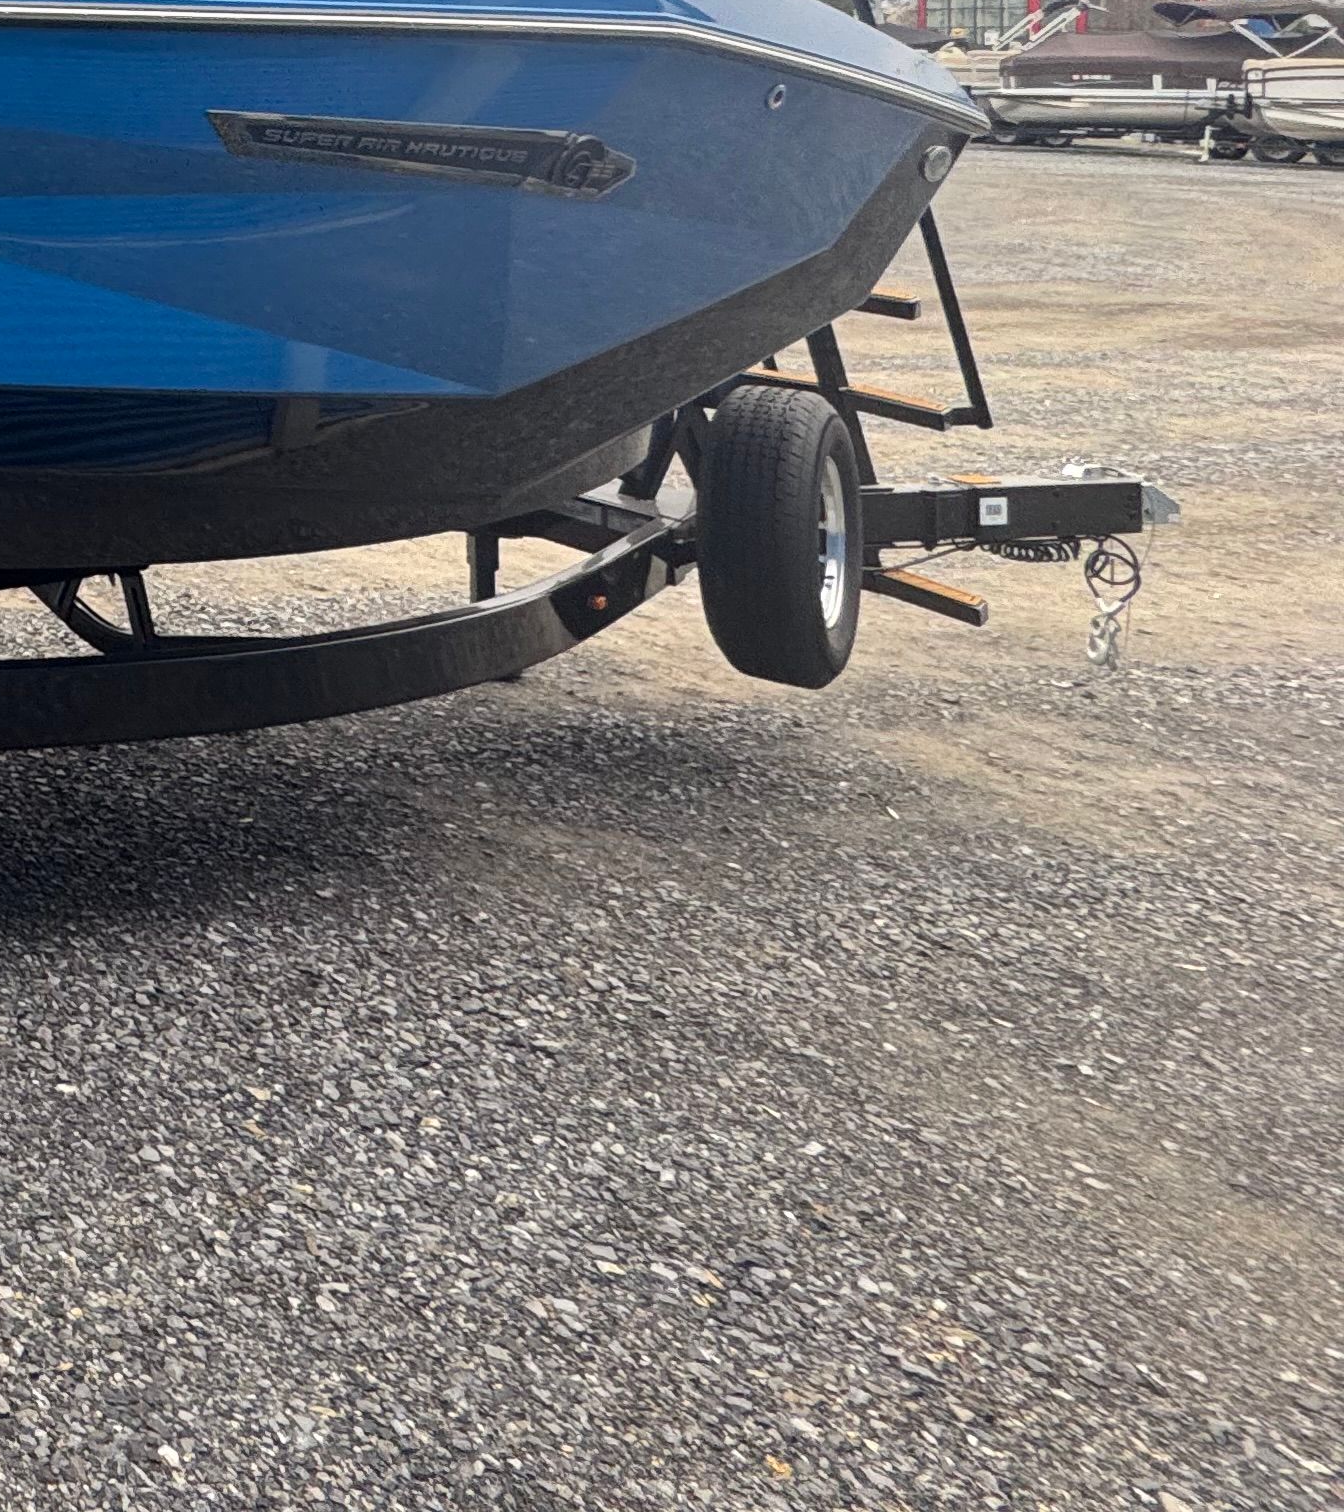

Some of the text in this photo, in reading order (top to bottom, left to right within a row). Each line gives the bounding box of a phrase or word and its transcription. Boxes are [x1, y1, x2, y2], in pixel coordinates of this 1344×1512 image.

[262, 127, 529, 164] SUPER AIR NAUTIQUE
